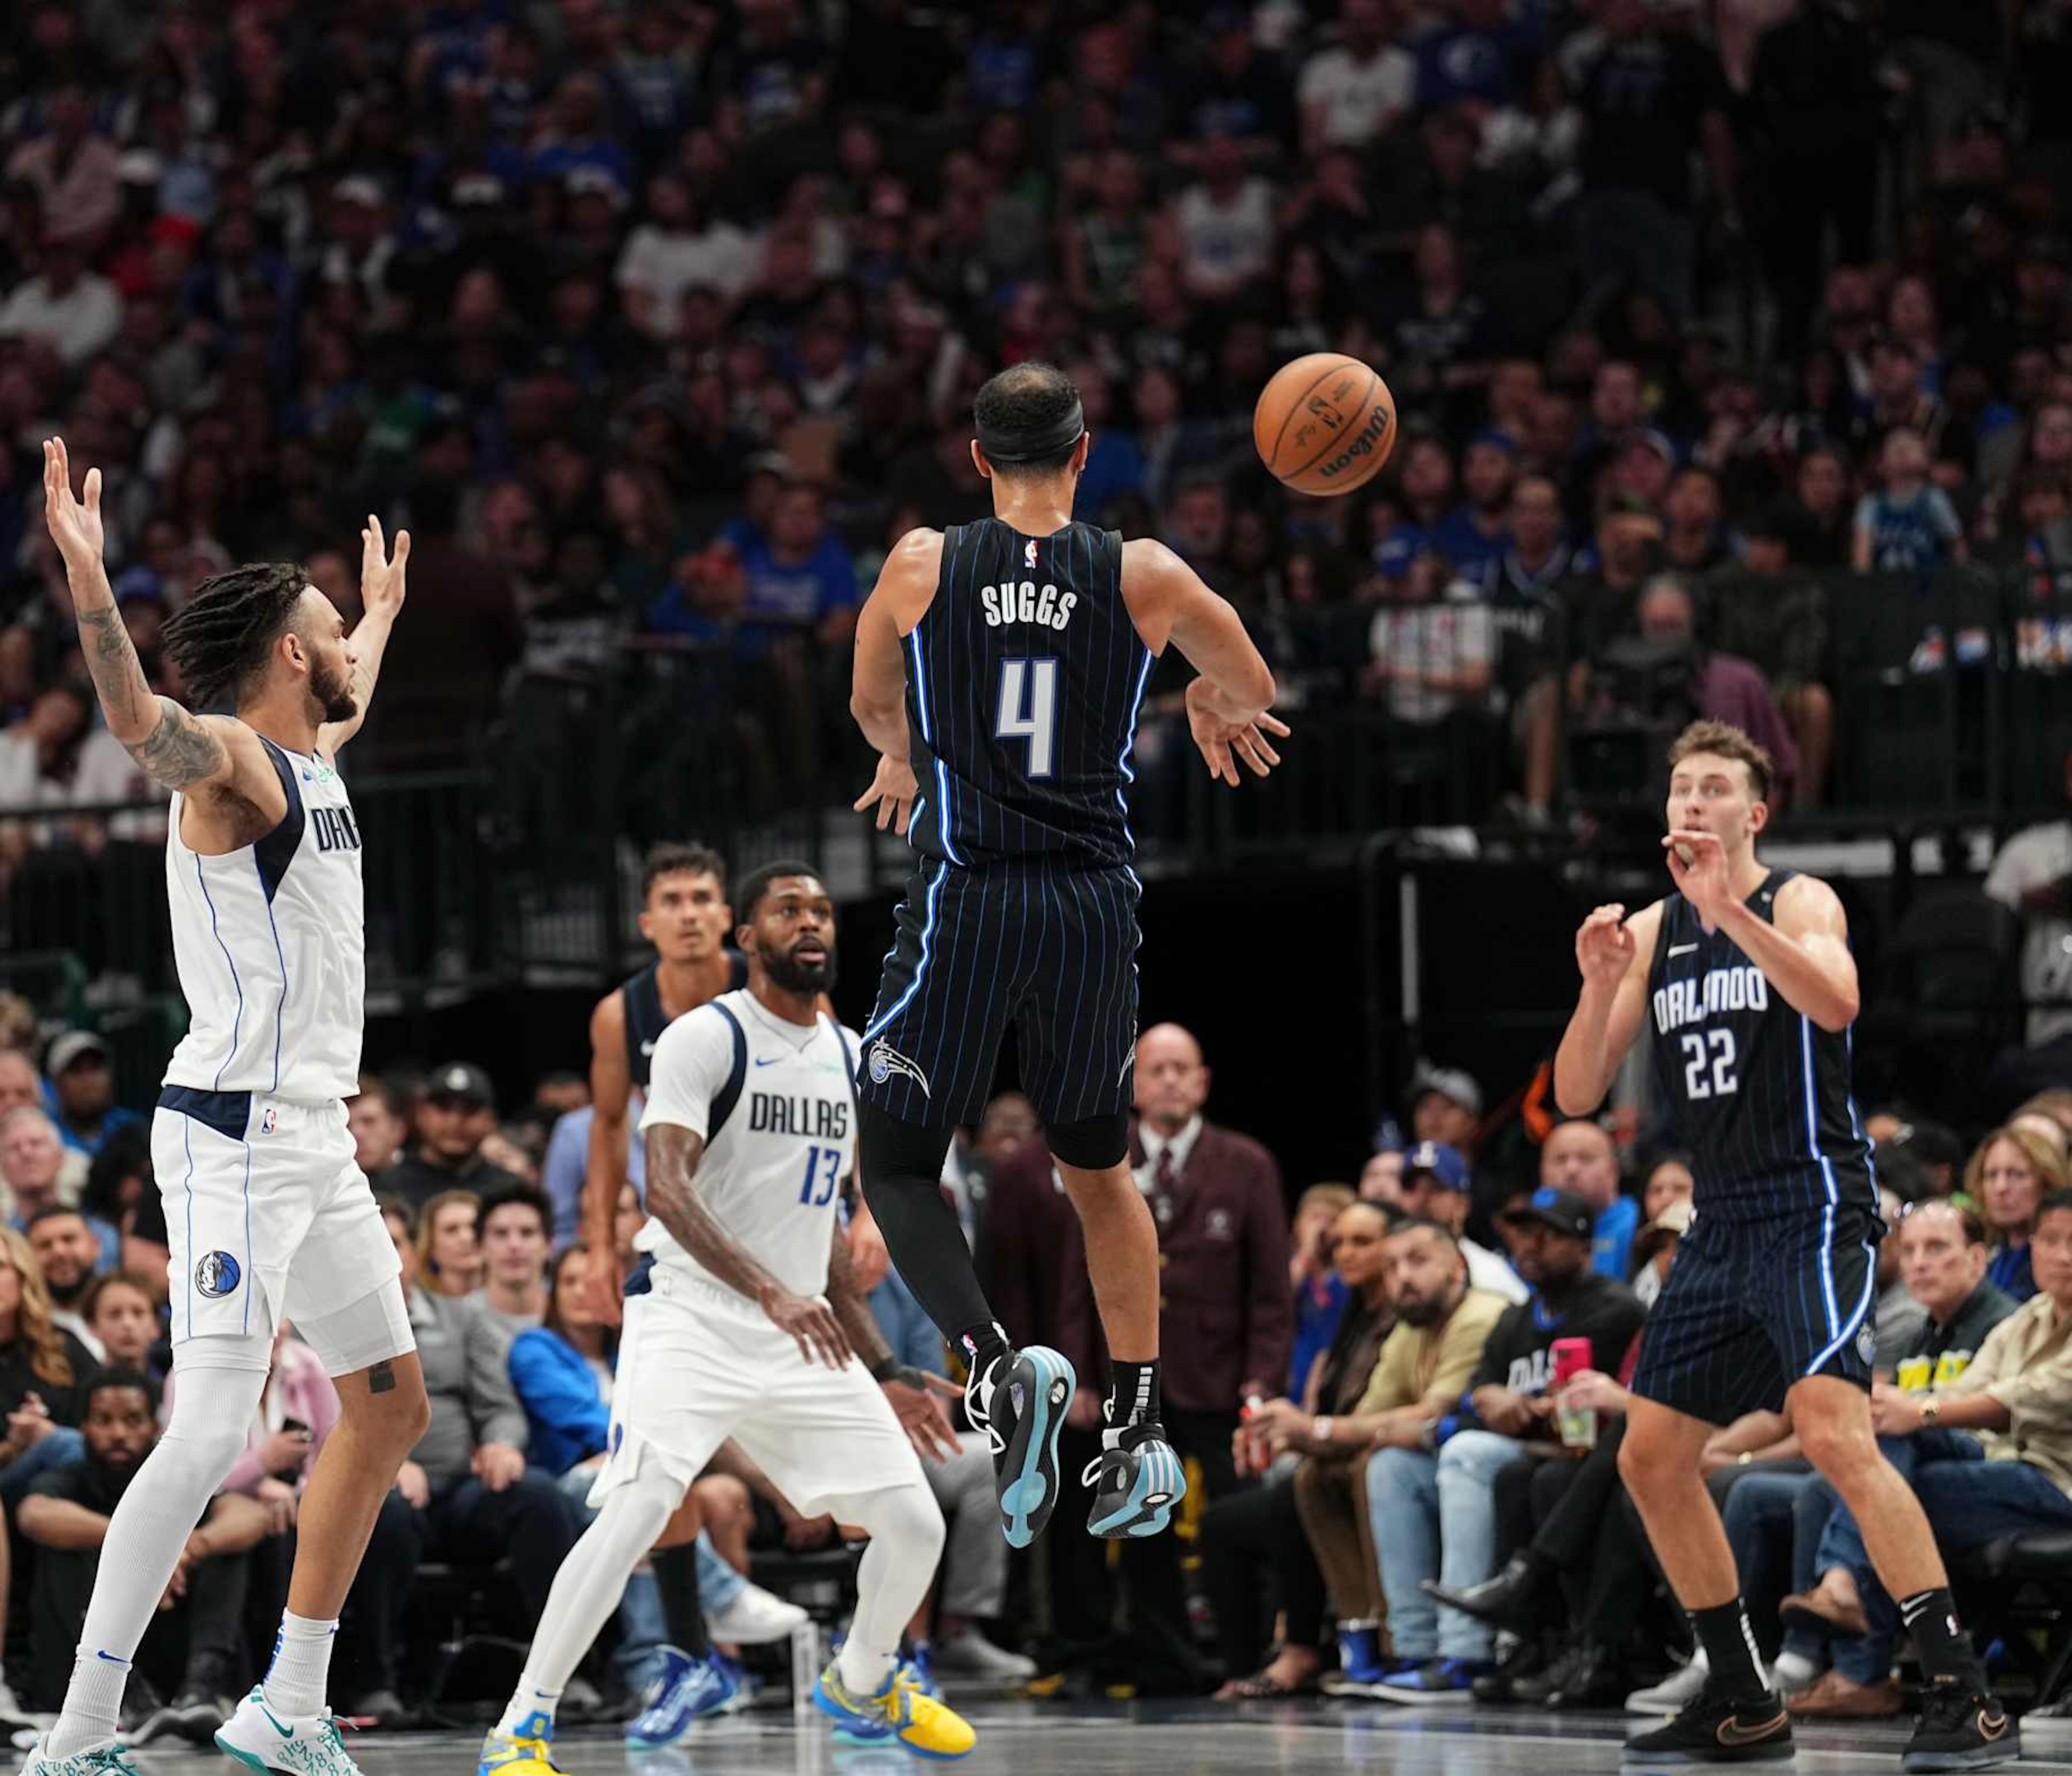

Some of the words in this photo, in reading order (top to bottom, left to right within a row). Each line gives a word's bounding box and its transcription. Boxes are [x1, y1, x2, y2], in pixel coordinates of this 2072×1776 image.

[981, 581, 1078, 630] SUGGS
[994, 658, 1059, 778] 4
[1681, 1027, 1738, 1099] 22
[749, 1092, 848, 1139] DALLAS
[799, 1146, 841, 1206] 13
